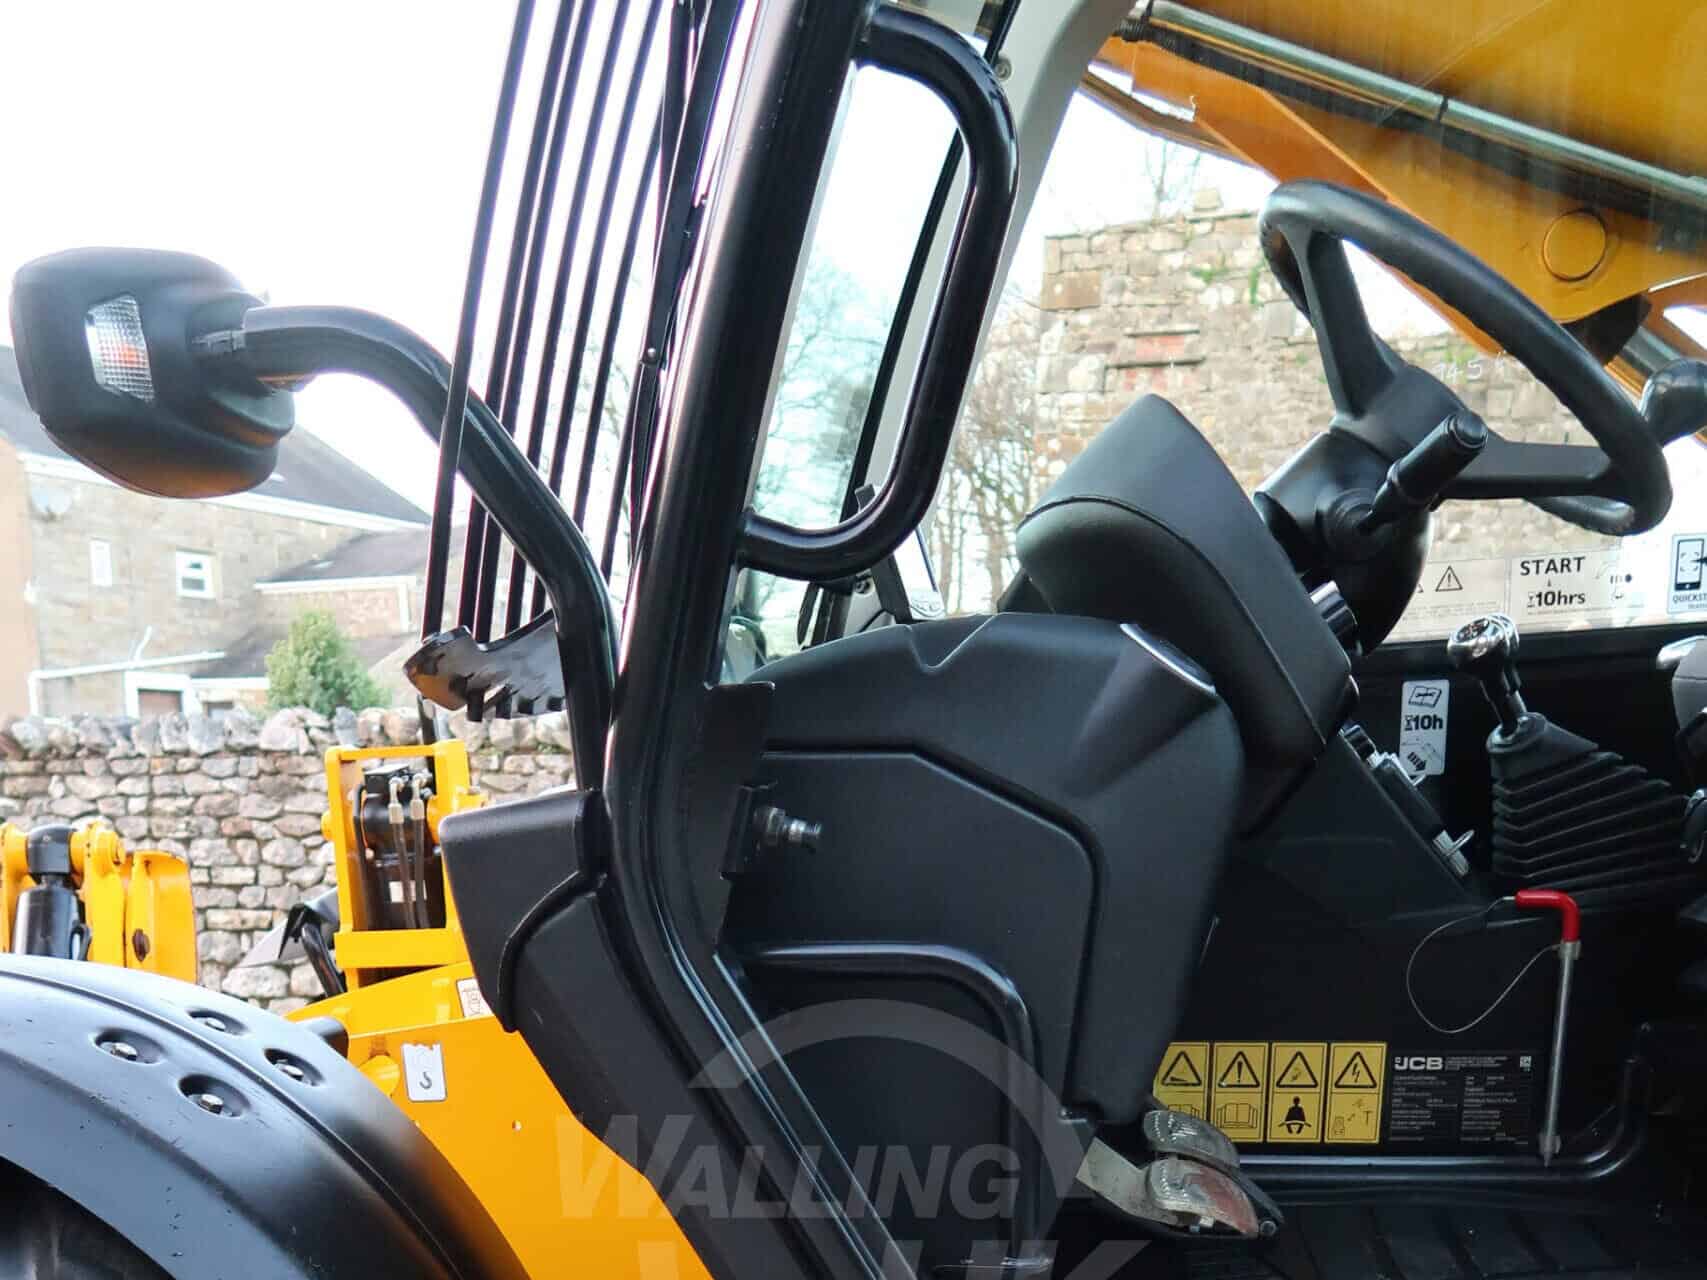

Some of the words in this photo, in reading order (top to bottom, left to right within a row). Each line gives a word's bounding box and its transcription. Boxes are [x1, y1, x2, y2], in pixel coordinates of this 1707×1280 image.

[1519, 556, 1586, 576] START
[1535, 589, 1586, 607] 10hrs
[1414, 714, 1444, 731] 10h
[1394, 1056, 1444, 1071] JCB
